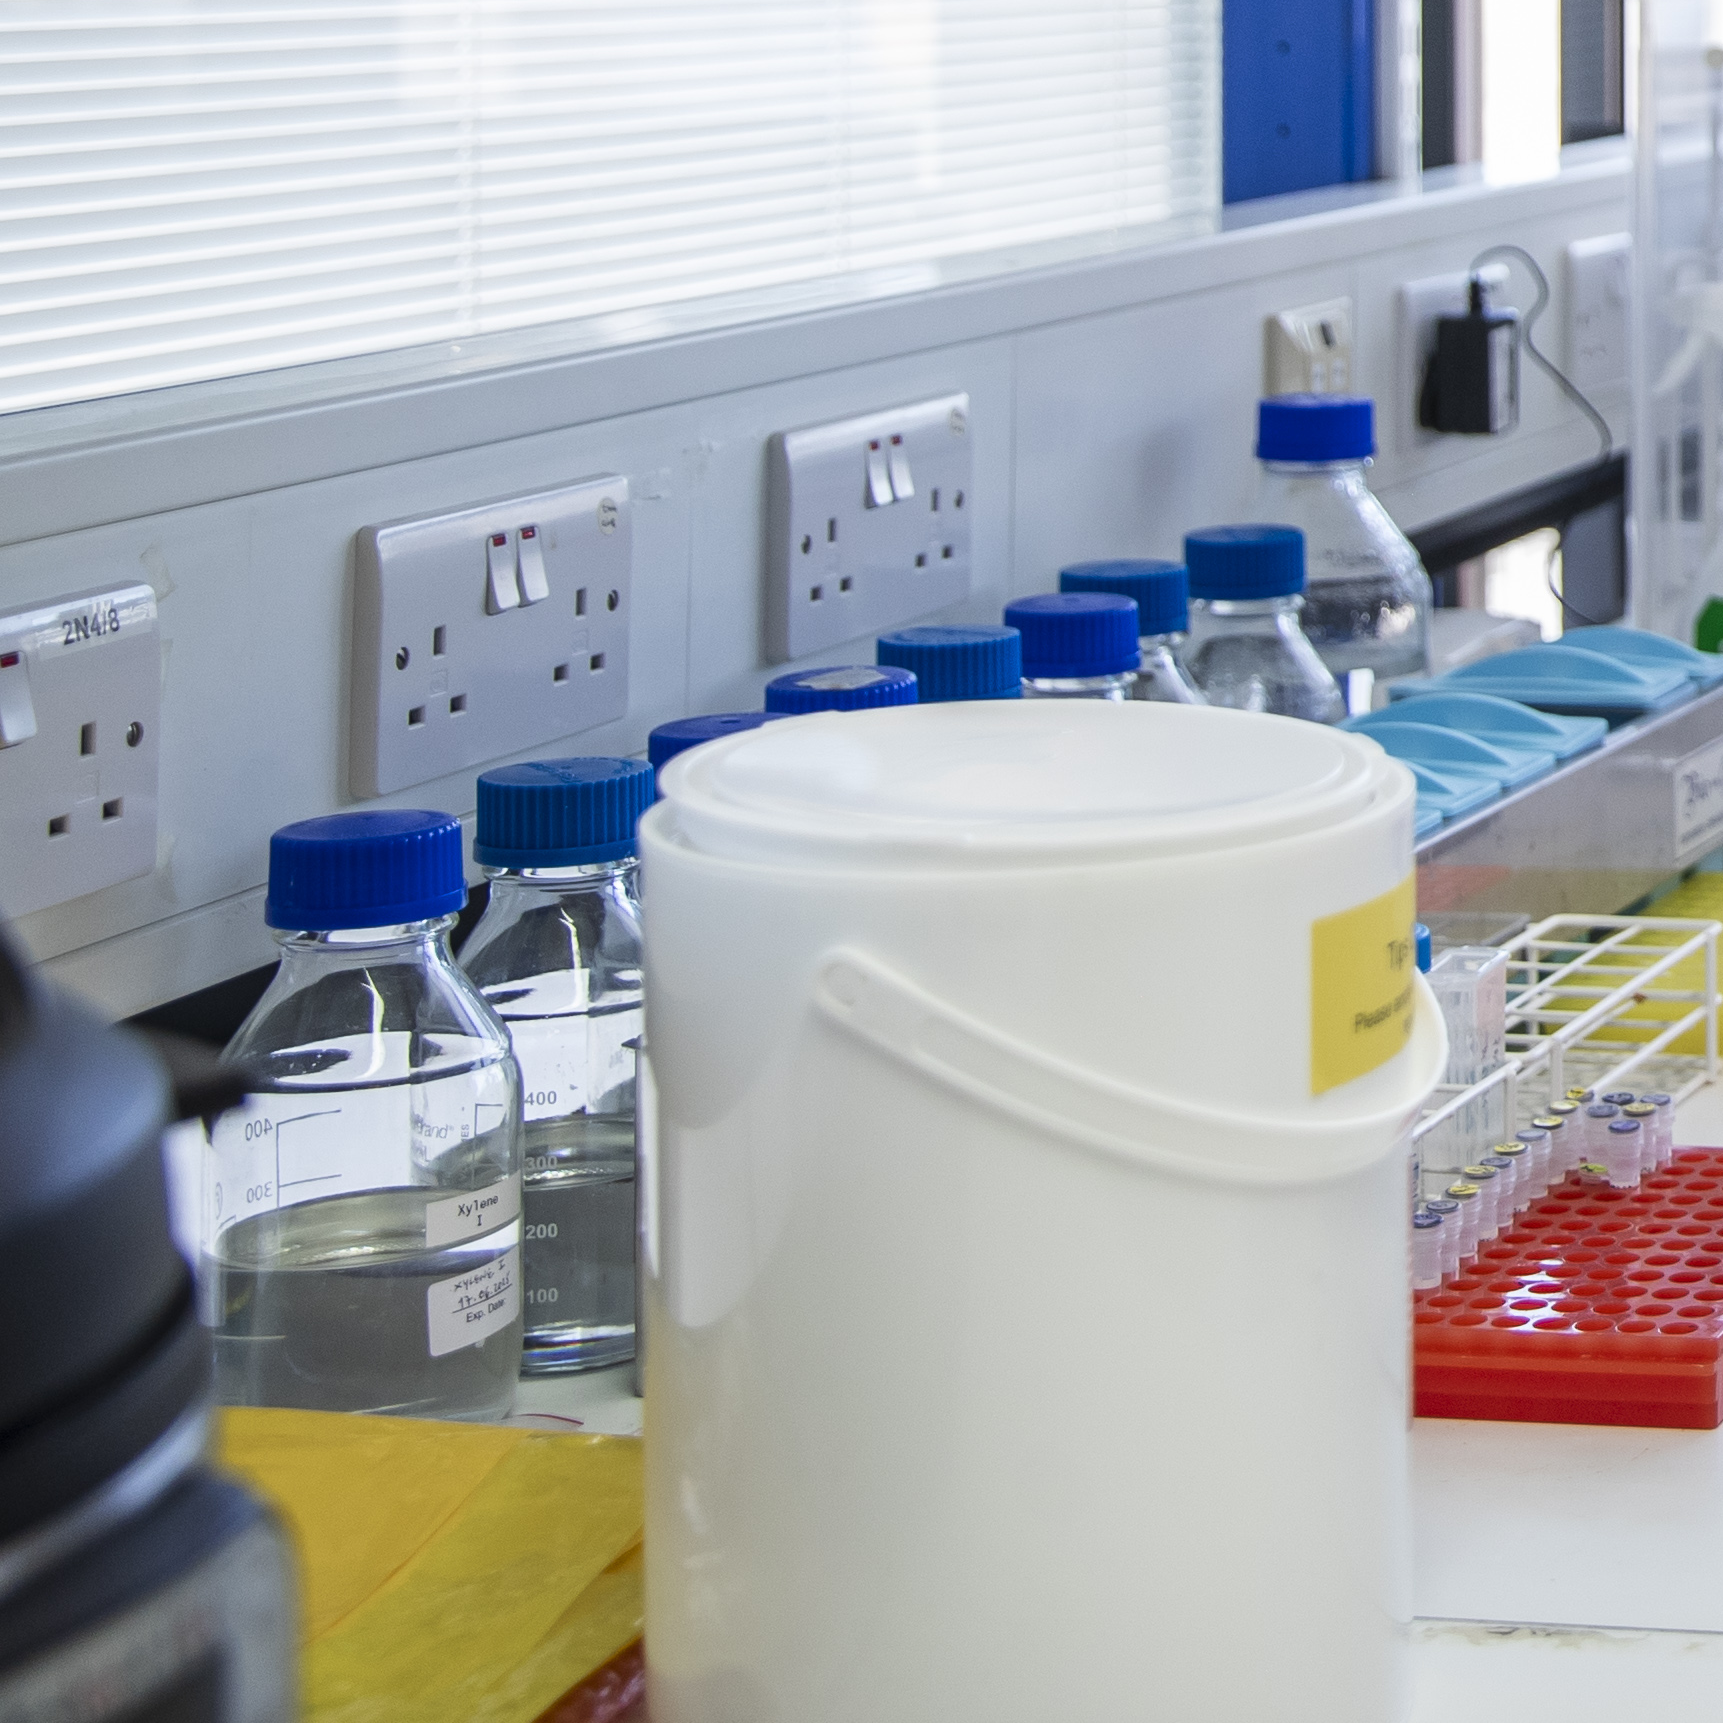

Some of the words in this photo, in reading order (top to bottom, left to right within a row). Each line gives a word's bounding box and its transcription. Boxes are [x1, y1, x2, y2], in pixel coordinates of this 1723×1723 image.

[524, 1090, 558, 1107] 400
[525, 1156, 558, 1171] 300
[457, 1194, 499, 1217] Xylene
[525, 1224, 558, 1239] 200
[527, 1288, 559, 1303] 100
